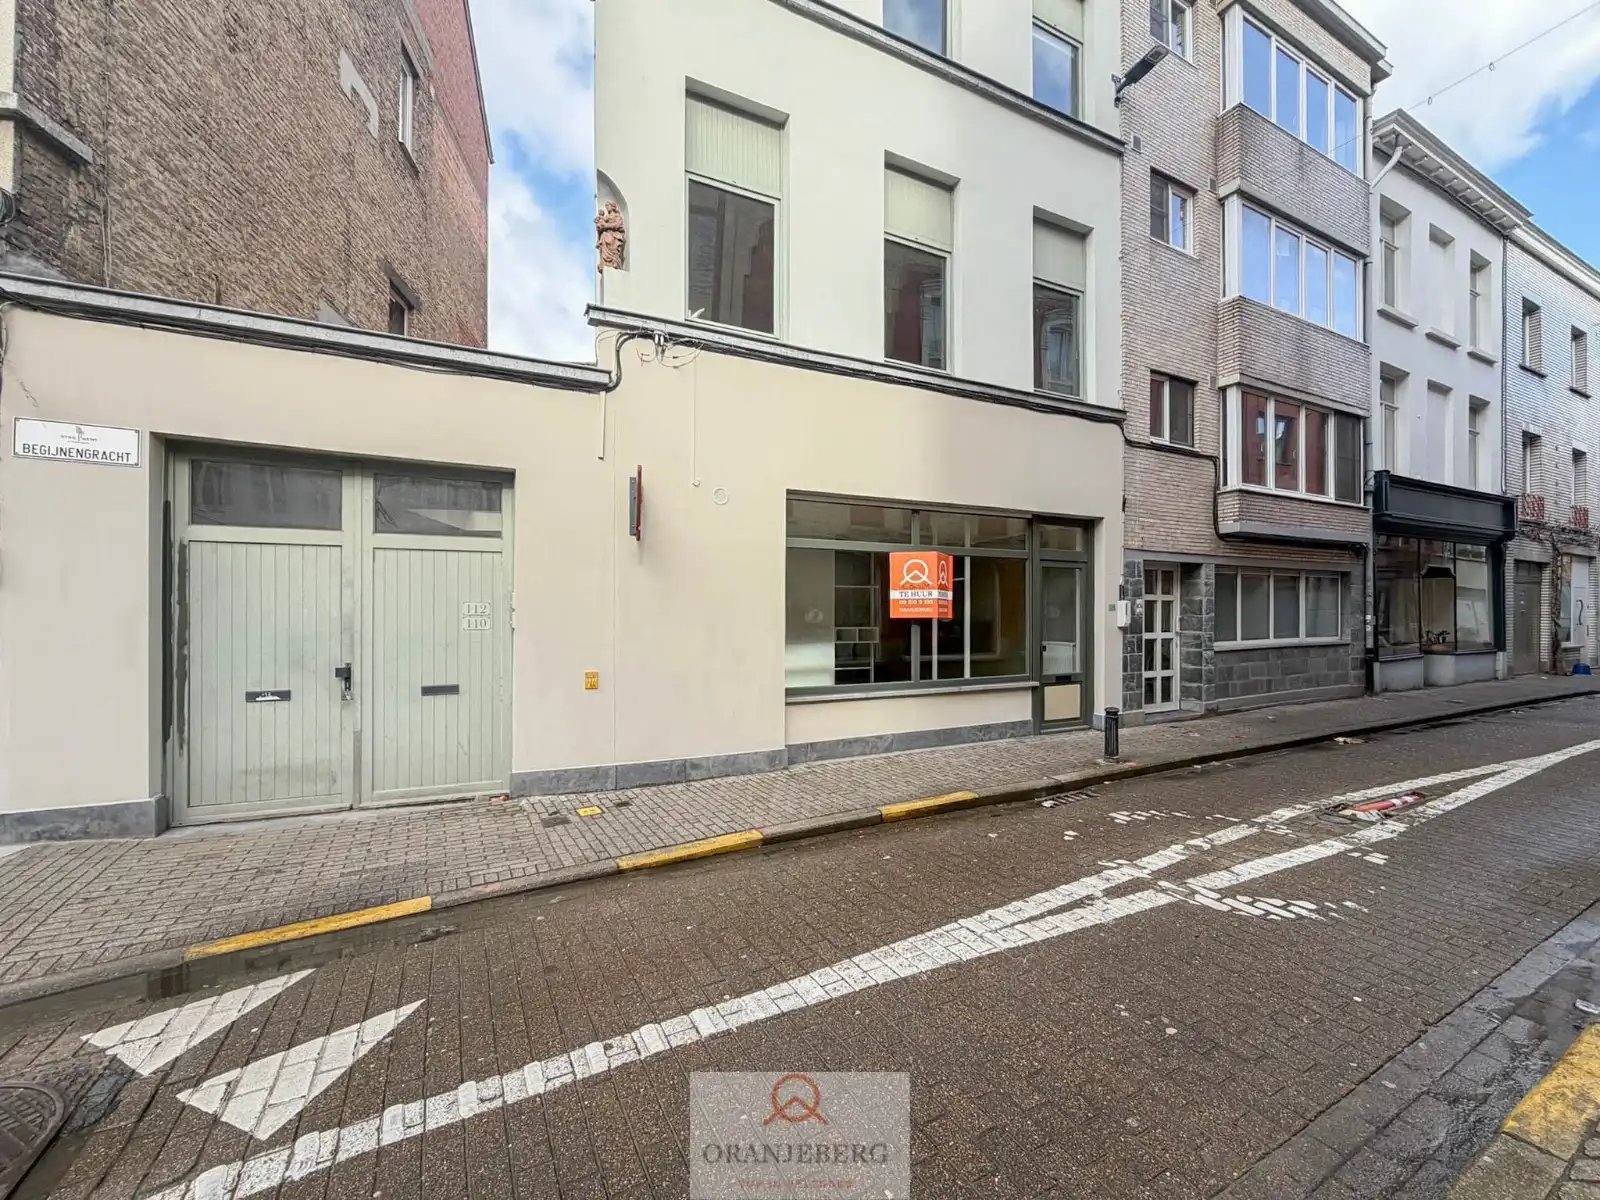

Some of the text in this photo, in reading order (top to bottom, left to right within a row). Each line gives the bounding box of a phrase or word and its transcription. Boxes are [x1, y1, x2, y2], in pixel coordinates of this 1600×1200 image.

[22, 442, 131, 463] BEGIJNENGRACHT
[467, 604, 487, 614] 112
[467, 618, 487, 629] 110
